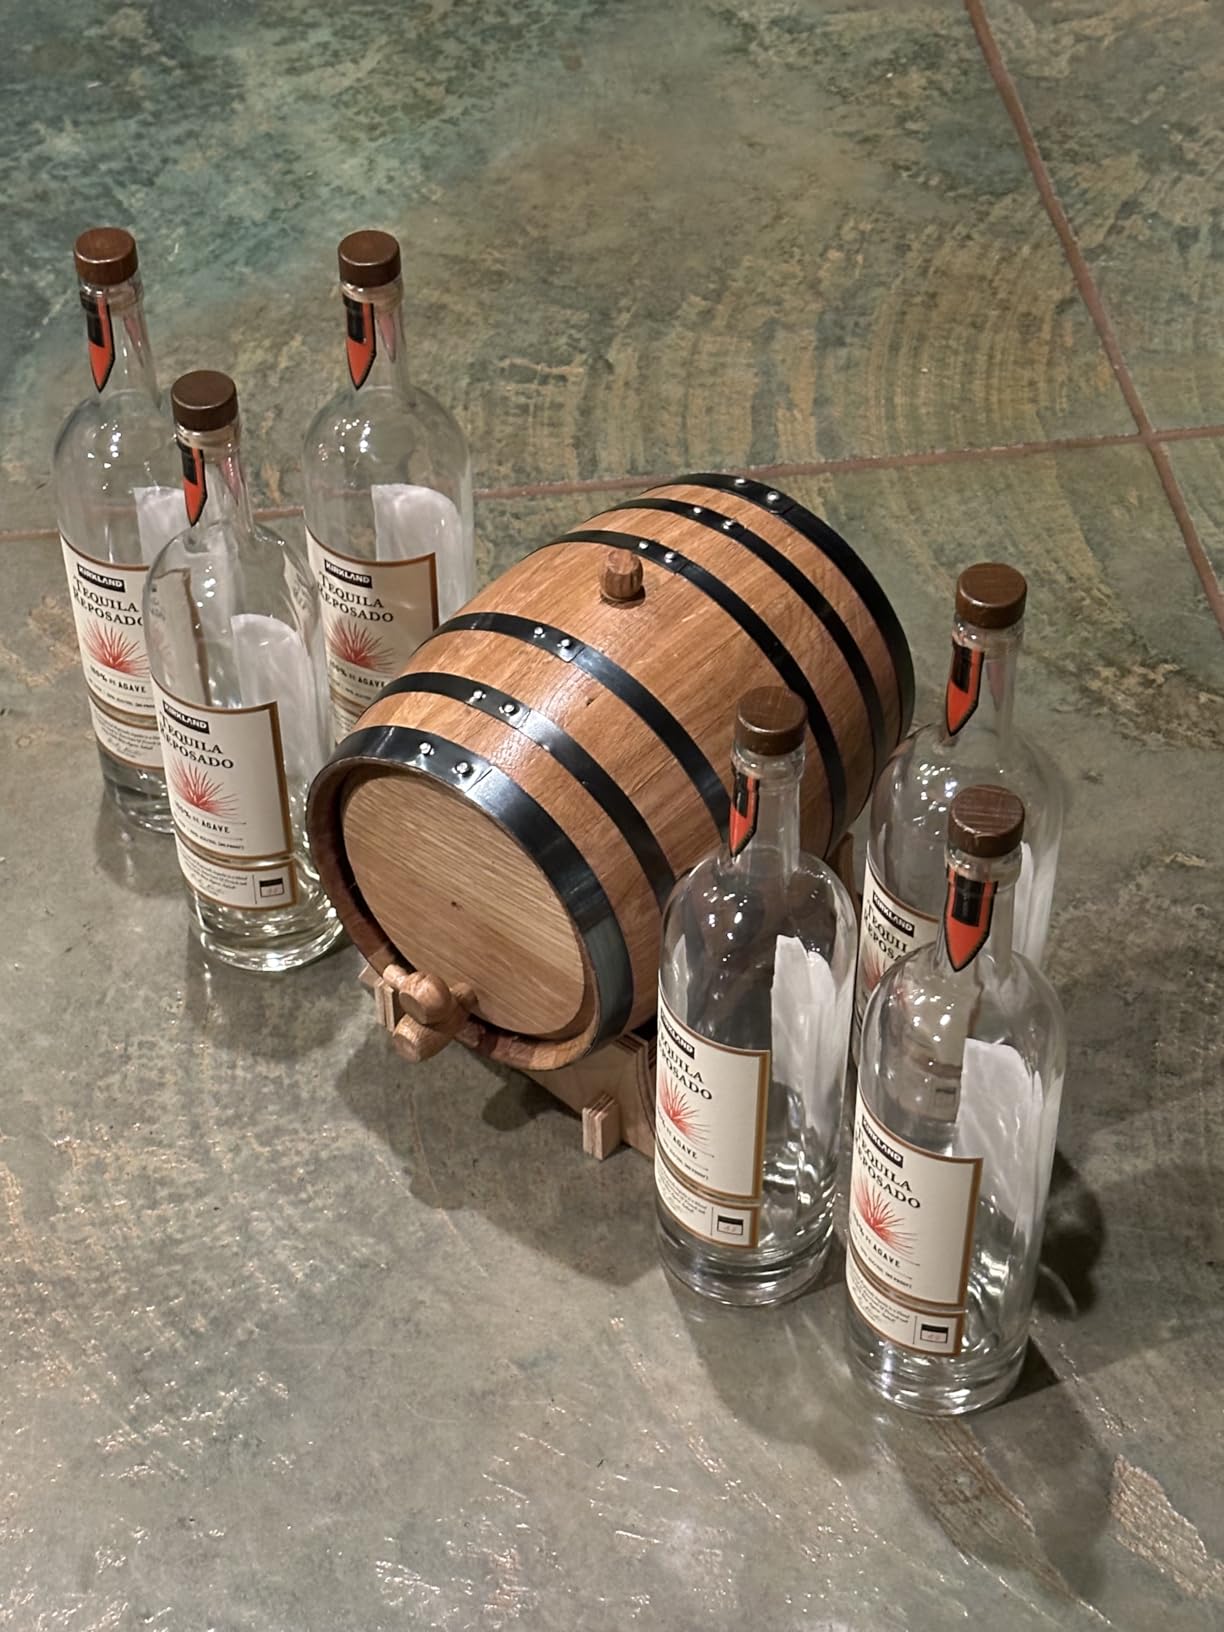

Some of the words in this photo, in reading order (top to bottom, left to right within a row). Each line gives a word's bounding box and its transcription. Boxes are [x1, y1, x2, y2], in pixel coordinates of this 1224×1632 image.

[79, 566, 124, 588] KIRKLAND
[325, 560, 371, 585] KIRKLAND
[73, 574, 139, 612] TEQUILA
[318, 571, 384, 609] TEQUILA
[118, 681, 146, 694] AGAVE
[159, 711, 223, 755] TEQUILA
[201, 821, 230, 834] AGAVE
[873, 892, 914, 932] KIRKLAND
[672, 1135, 698, 1160] AGAVE
[872, 1244, 901, 1269] AGAVE
